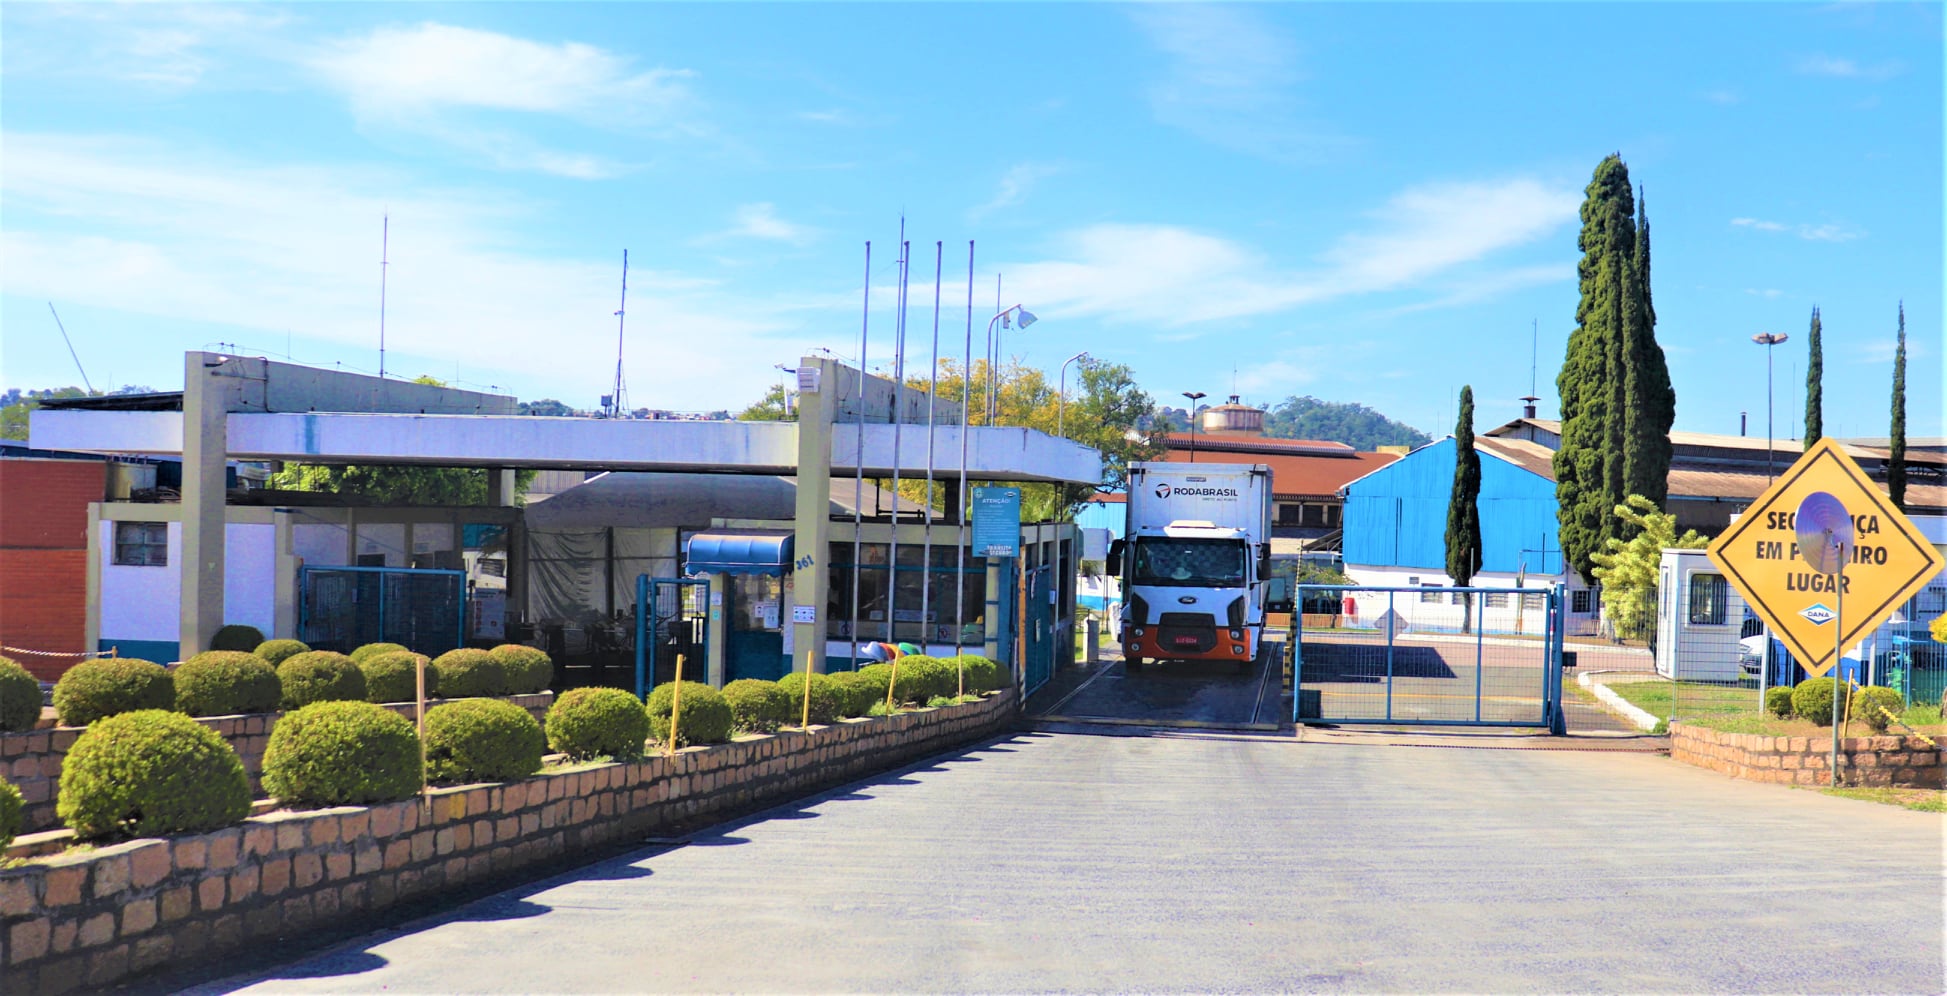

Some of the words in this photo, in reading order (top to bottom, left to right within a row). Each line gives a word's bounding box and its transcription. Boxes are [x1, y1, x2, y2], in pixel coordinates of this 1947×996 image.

[1174, 487, 1238, 496] RODABRASIL
[795, 554, 815, 570] 361
[1756, 541, 1782, 560] EM
[1790, 542, 1888, 565] PIRO
[1786, 572, 1850, 594] LUGAR
